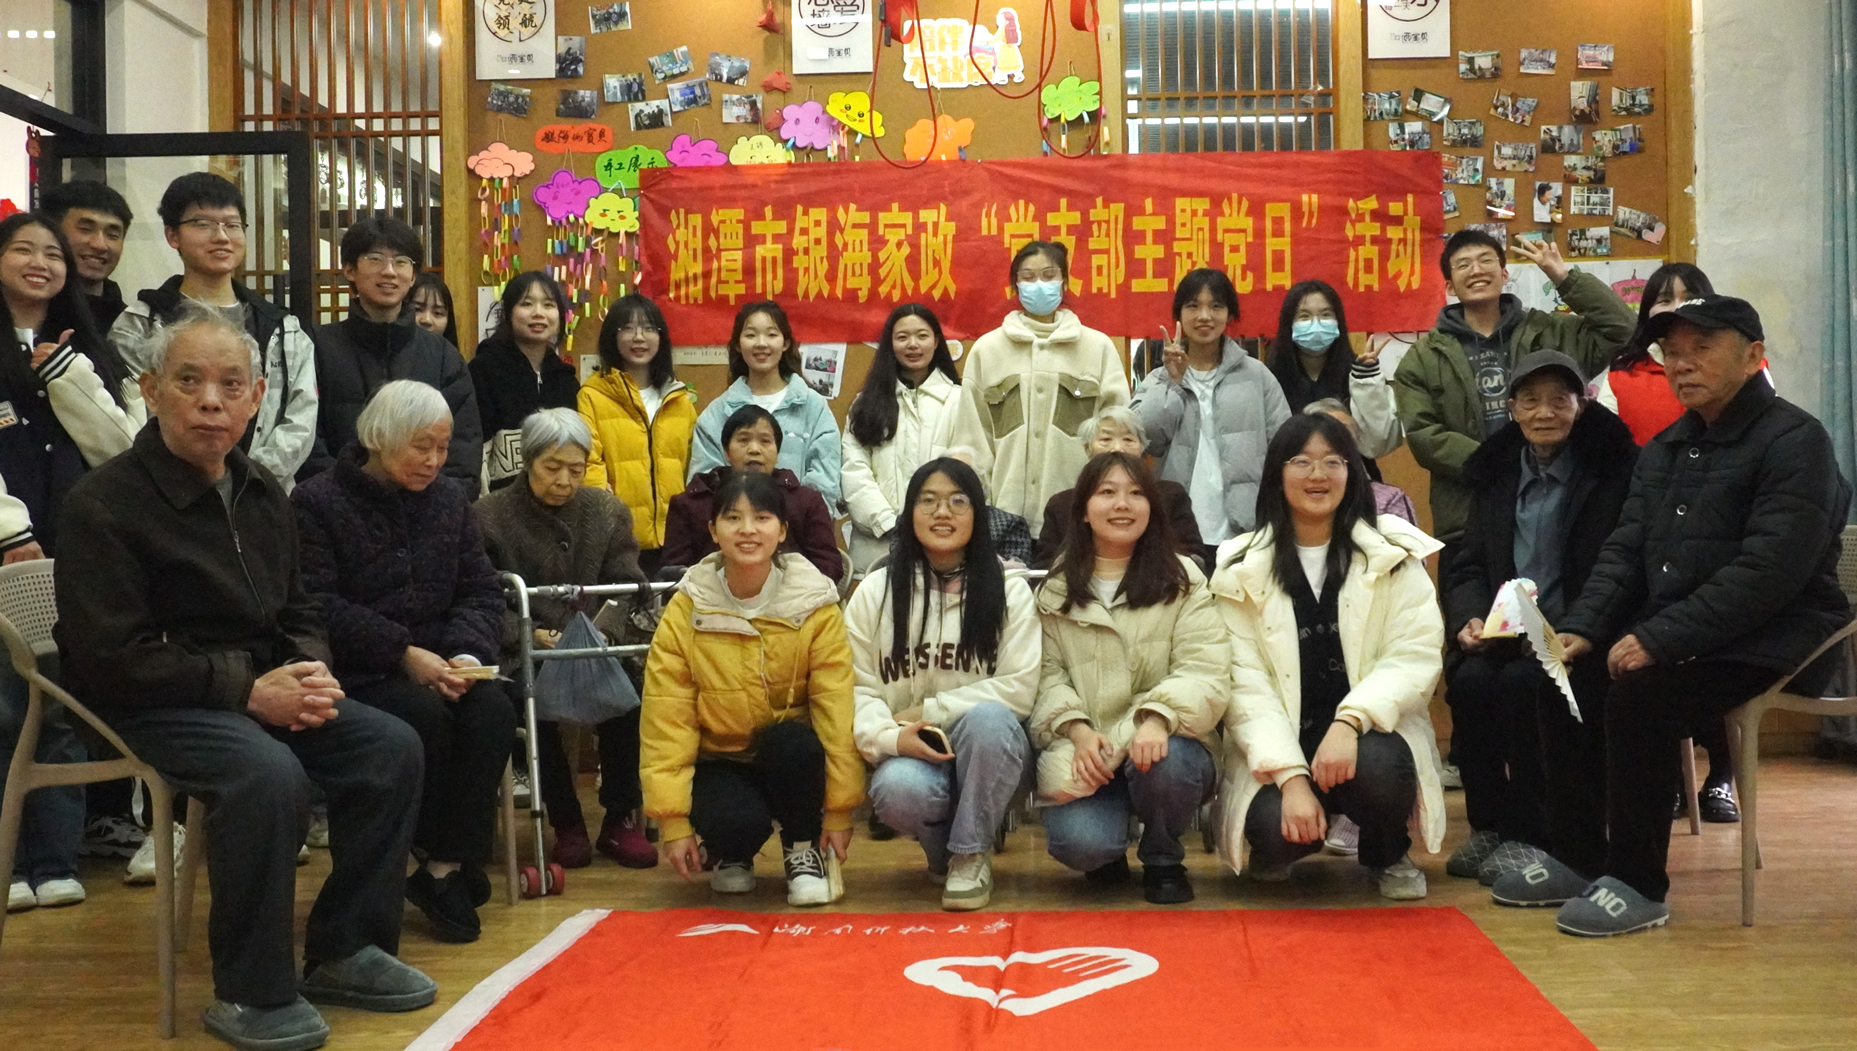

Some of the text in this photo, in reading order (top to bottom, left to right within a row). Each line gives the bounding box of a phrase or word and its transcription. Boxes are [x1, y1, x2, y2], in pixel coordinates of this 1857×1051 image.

[494, 12, 537, 34] 领航
[603, 154, 659, 178] 手工展示
[1588, 887, 1628, 918] NO
